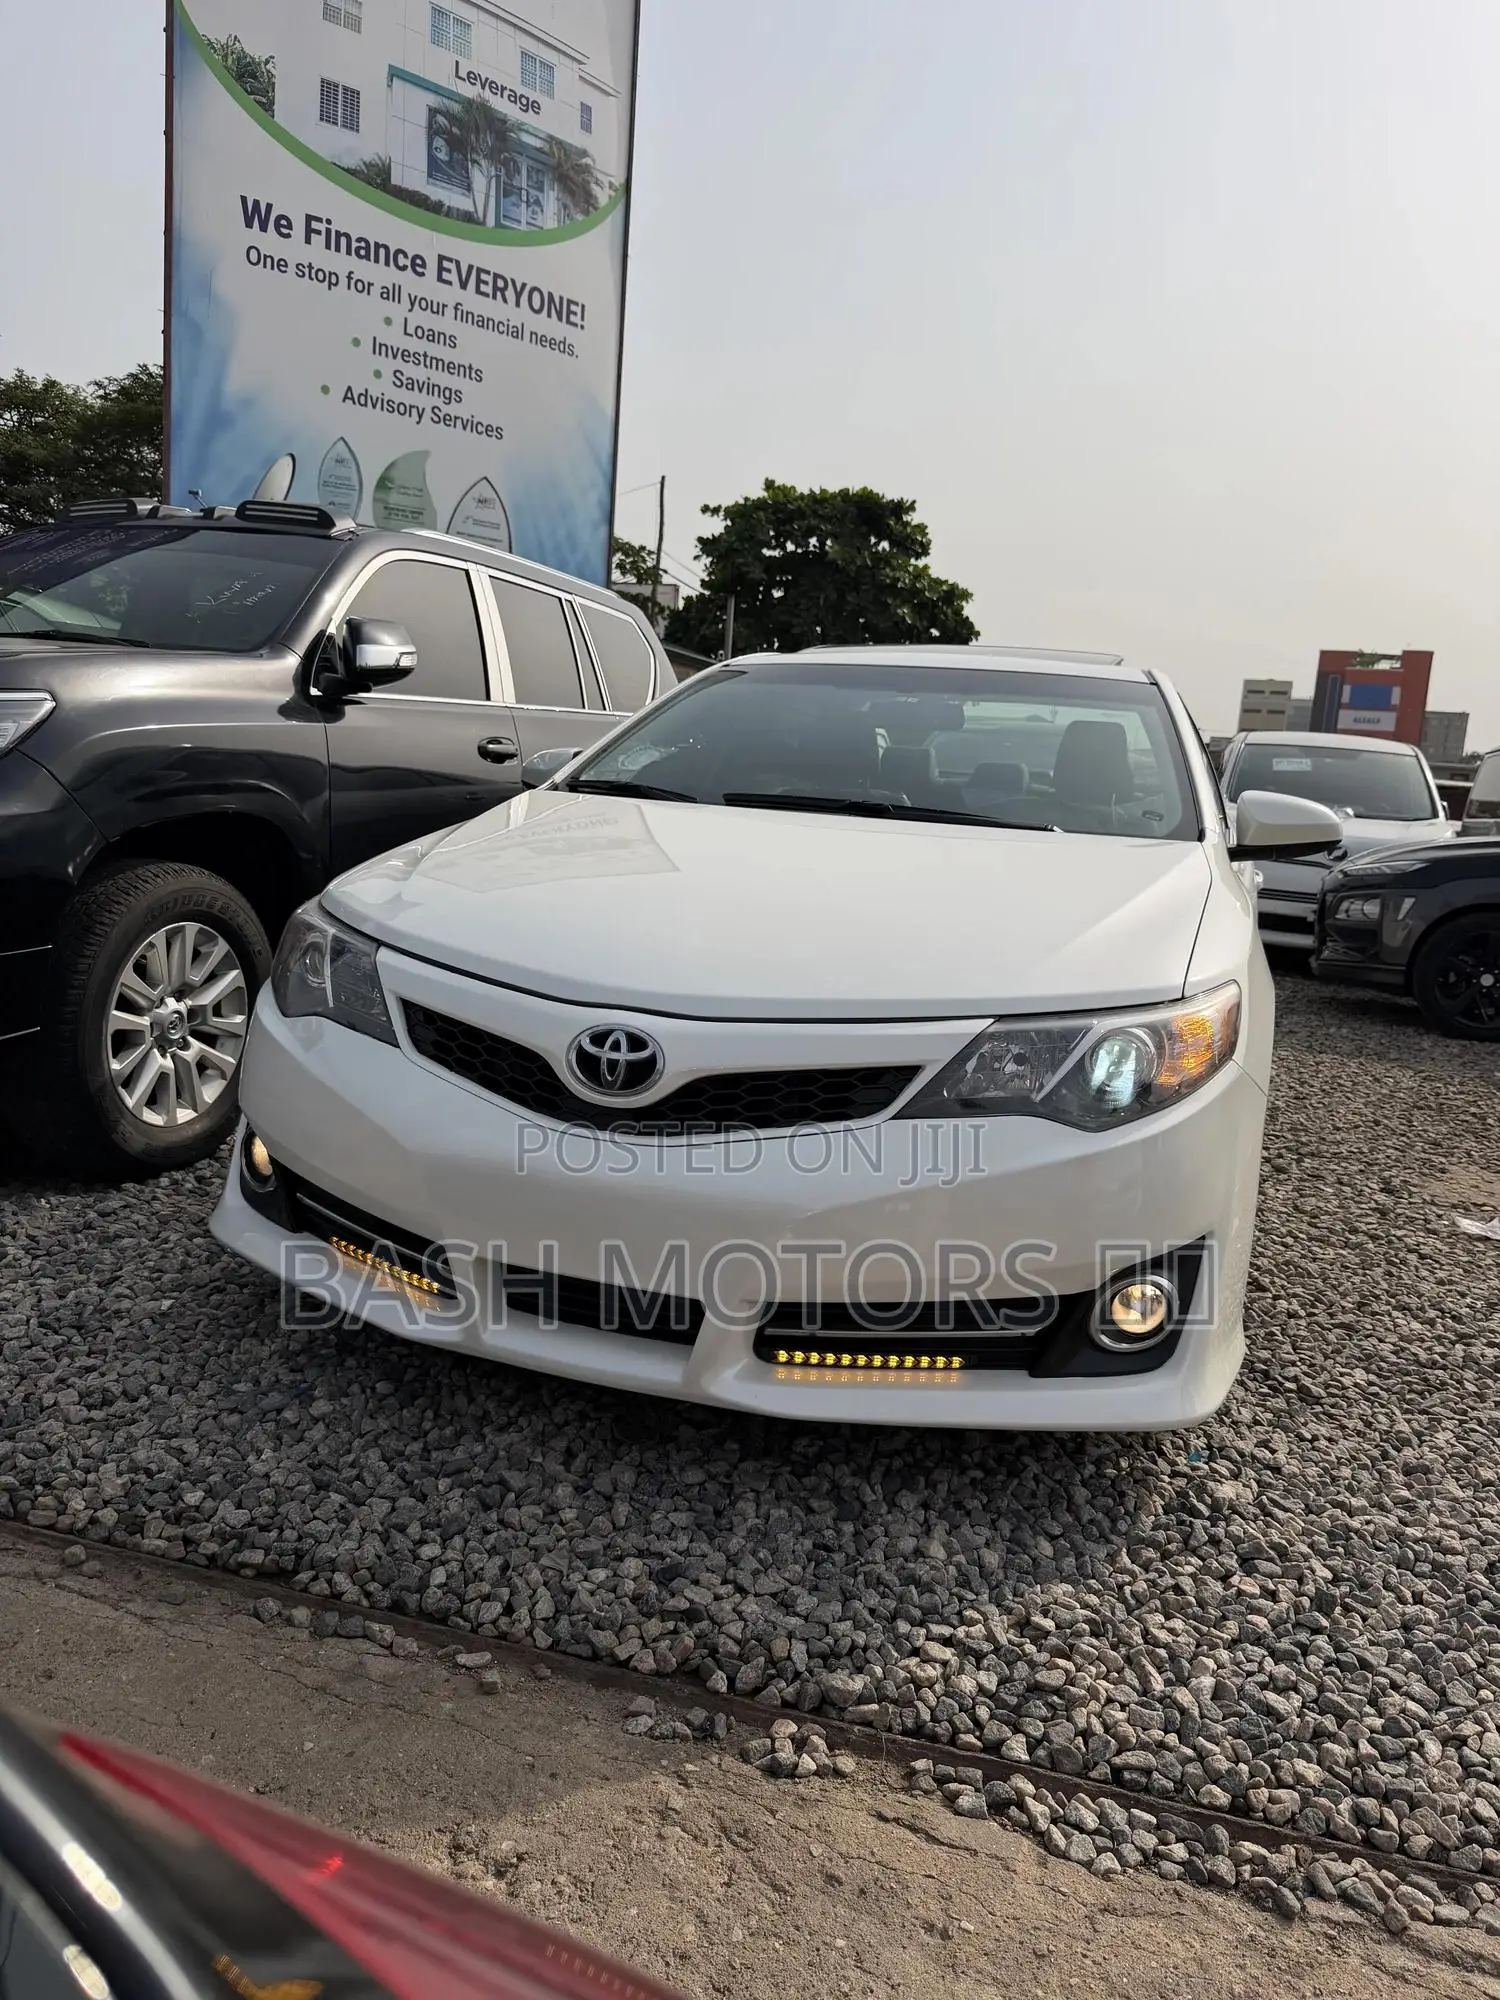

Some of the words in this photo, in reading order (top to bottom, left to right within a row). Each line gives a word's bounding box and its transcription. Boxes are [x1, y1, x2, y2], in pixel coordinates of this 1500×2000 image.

[455, 60, 541, 115] Leverage
[240, 195, 293, 239] We
[304, 213, 427, 277] Finance
[436, 253, 586, 330] EVERYONE!
[246, 246, 288, 273] One
[295, 262, 340, 290] stop
[346, 271, 374, 295] for
[380, 283, 401, 304] all
[408, 293, 448, 316] your
[453, 302, 525, 341] financial
[529, 330, 579, 358] needs.
[372, 336, 483, 383] Investments
[403, 317, 458, 349] Loans
[342, 385, 425, 425] Advisory
[430, 406, 504, 440] Services
[392, 370, 463, 405] Savings
